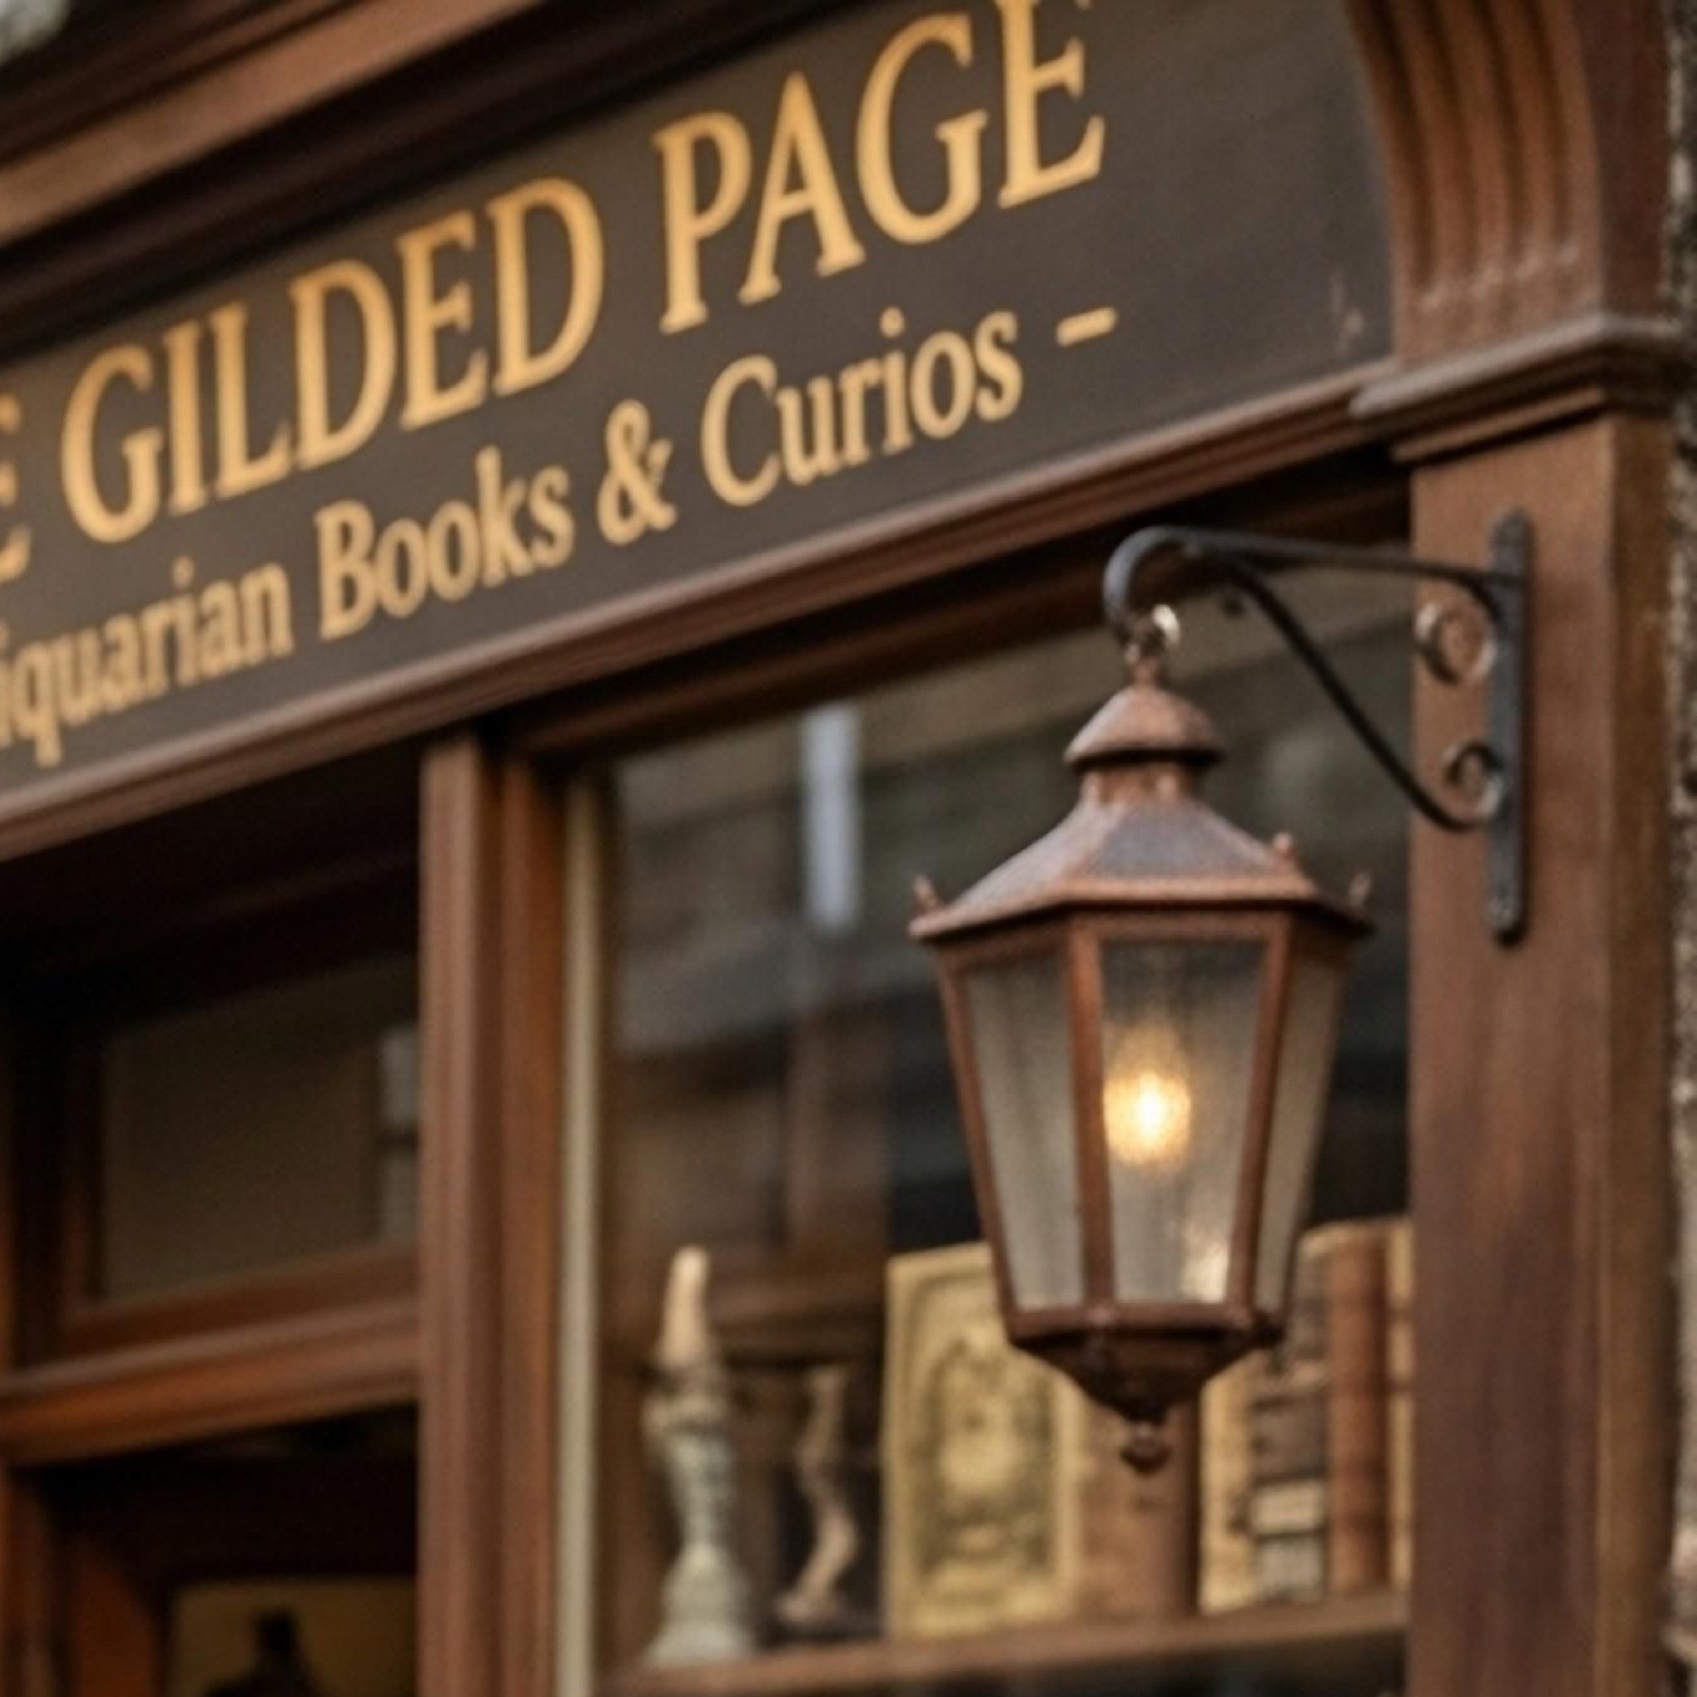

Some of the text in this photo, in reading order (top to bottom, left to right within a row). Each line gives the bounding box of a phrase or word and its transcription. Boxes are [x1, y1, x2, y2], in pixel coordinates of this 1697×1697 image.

[61, 177, 604, 542] GILDED
[653, 0, 1104, 334] PAGE
[314, 446, 573, 639] Books
[598, 400, 675, 545] &
[701, 307, 1022, 508] Curios
